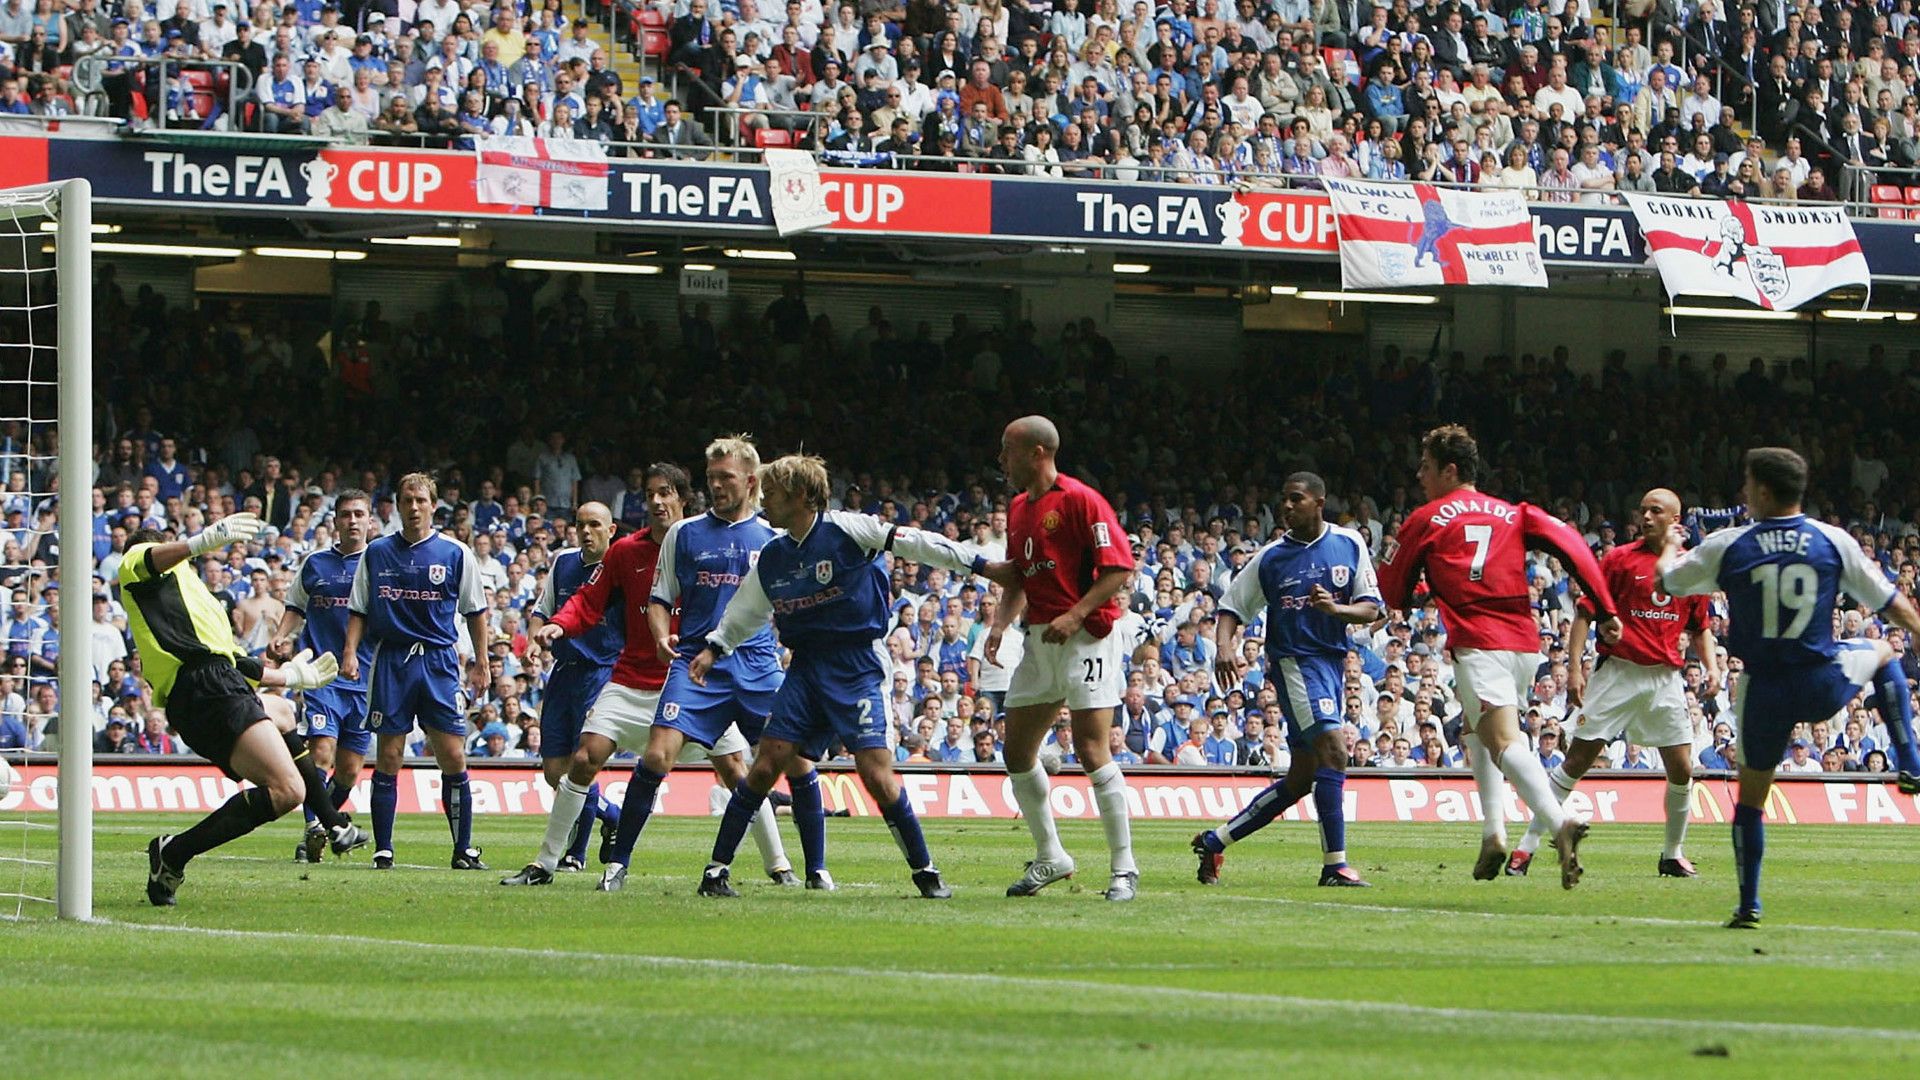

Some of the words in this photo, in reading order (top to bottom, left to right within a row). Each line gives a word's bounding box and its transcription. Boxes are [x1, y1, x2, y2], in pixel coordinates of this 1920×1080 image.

[348, 160, 442, 203] CUP
[1328, 180, 1416, 199] MILLWALL
[820, 181, 904, 223] CUP
[1647, 202, 1716, 220] COOKIE
[1258, 202, 1338, 244] CUP
[1463, 250, 1519, 262] WEMBLEY
[1488, 264, 1505, 275] 99
[685, 274, 724, 289] Toilet
[1464, 525, 1493, 581] 7
[1755, 529, 1813, 556] WISE
[378, 585, 443, 601] Ryman
[1751, 563, 1819, 639] 19
[1083, 658, 1102, 682] 27
[857, 698, 873, 725] 2
[413, 769, 669, 816] Parter
[902, 774, 991, 816] FA
[1389, 779, 1618, 824] Parter
[1824, 782, 1906, 824] FA
